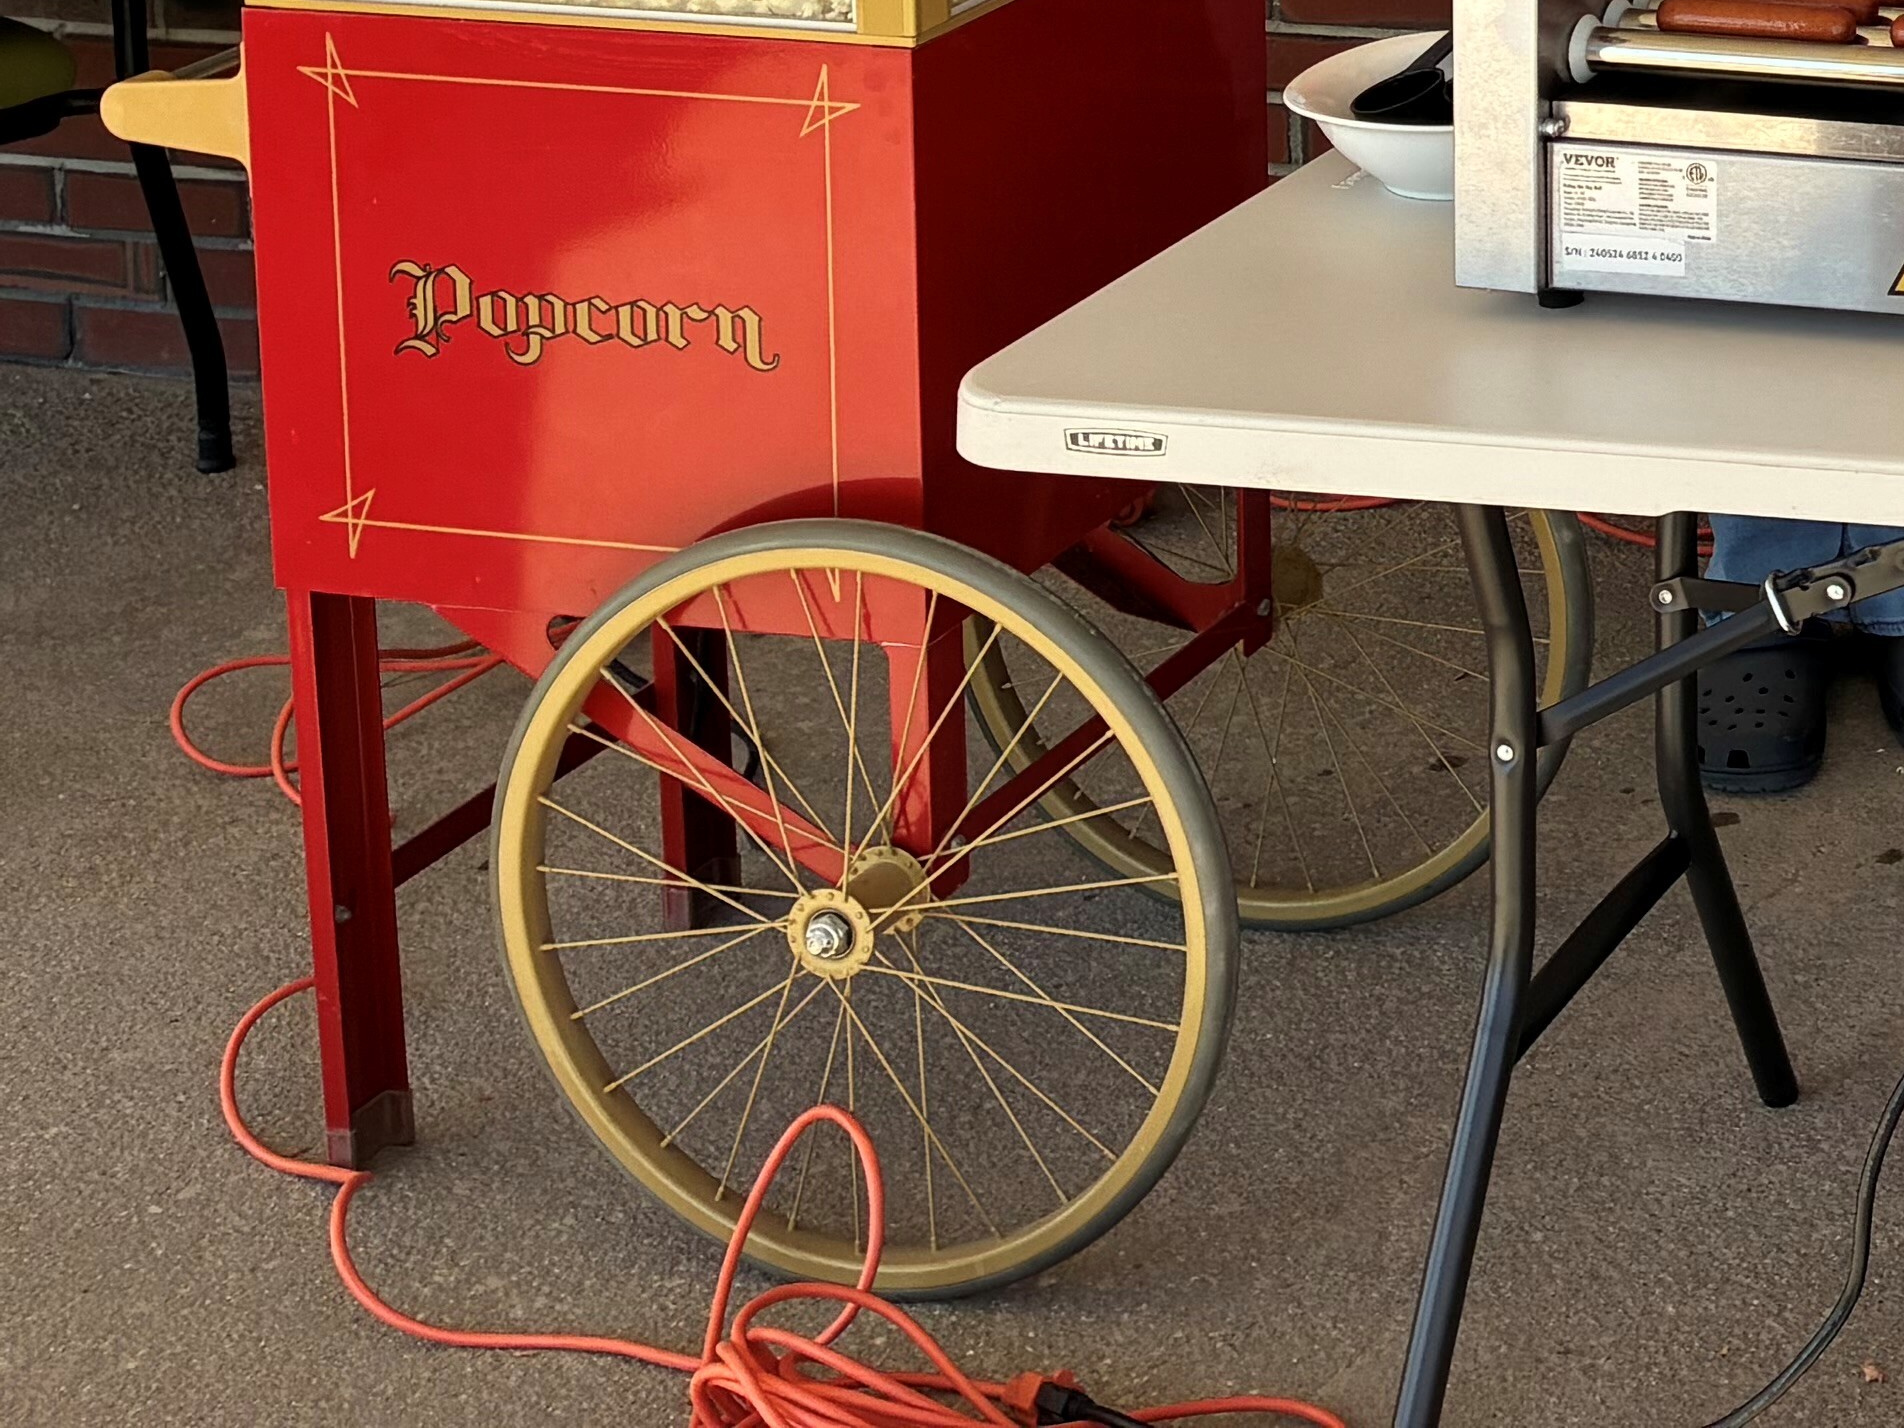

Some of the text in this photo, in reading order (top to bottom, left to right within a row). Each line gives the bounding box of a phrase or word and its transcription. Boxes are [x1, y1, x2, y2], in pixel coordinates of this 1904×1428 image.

[1563, 153, 1616, 169] VEVOR
[389, 259, 780, 373] Popcorn
[1077, 432, 1155, 451] LIFETIME
